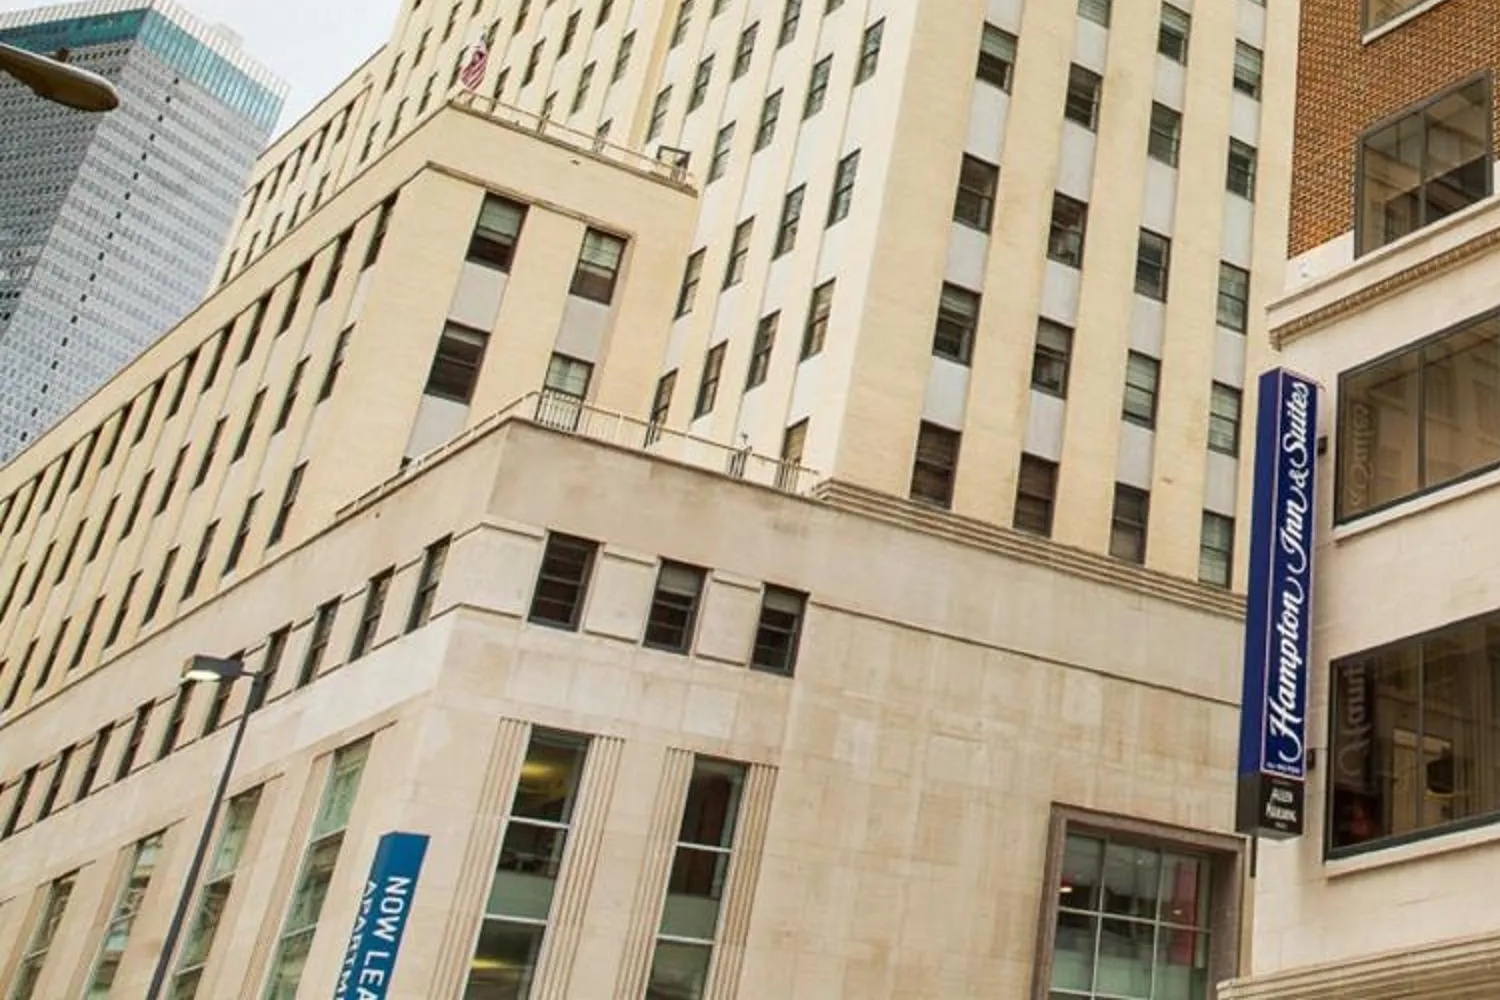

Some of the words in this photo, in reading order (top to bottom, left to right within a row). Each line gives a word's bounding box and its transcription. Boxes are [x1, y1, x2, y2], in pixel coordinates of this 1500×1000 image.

[1282, 381, 1309, 469] Suites
[1288, 467, 1309, 488] &
[1279, 485, 1308, 574] Inn
[1269, 576, 1306, 763] Hampton
[372, 876, 412, 942] NOW
